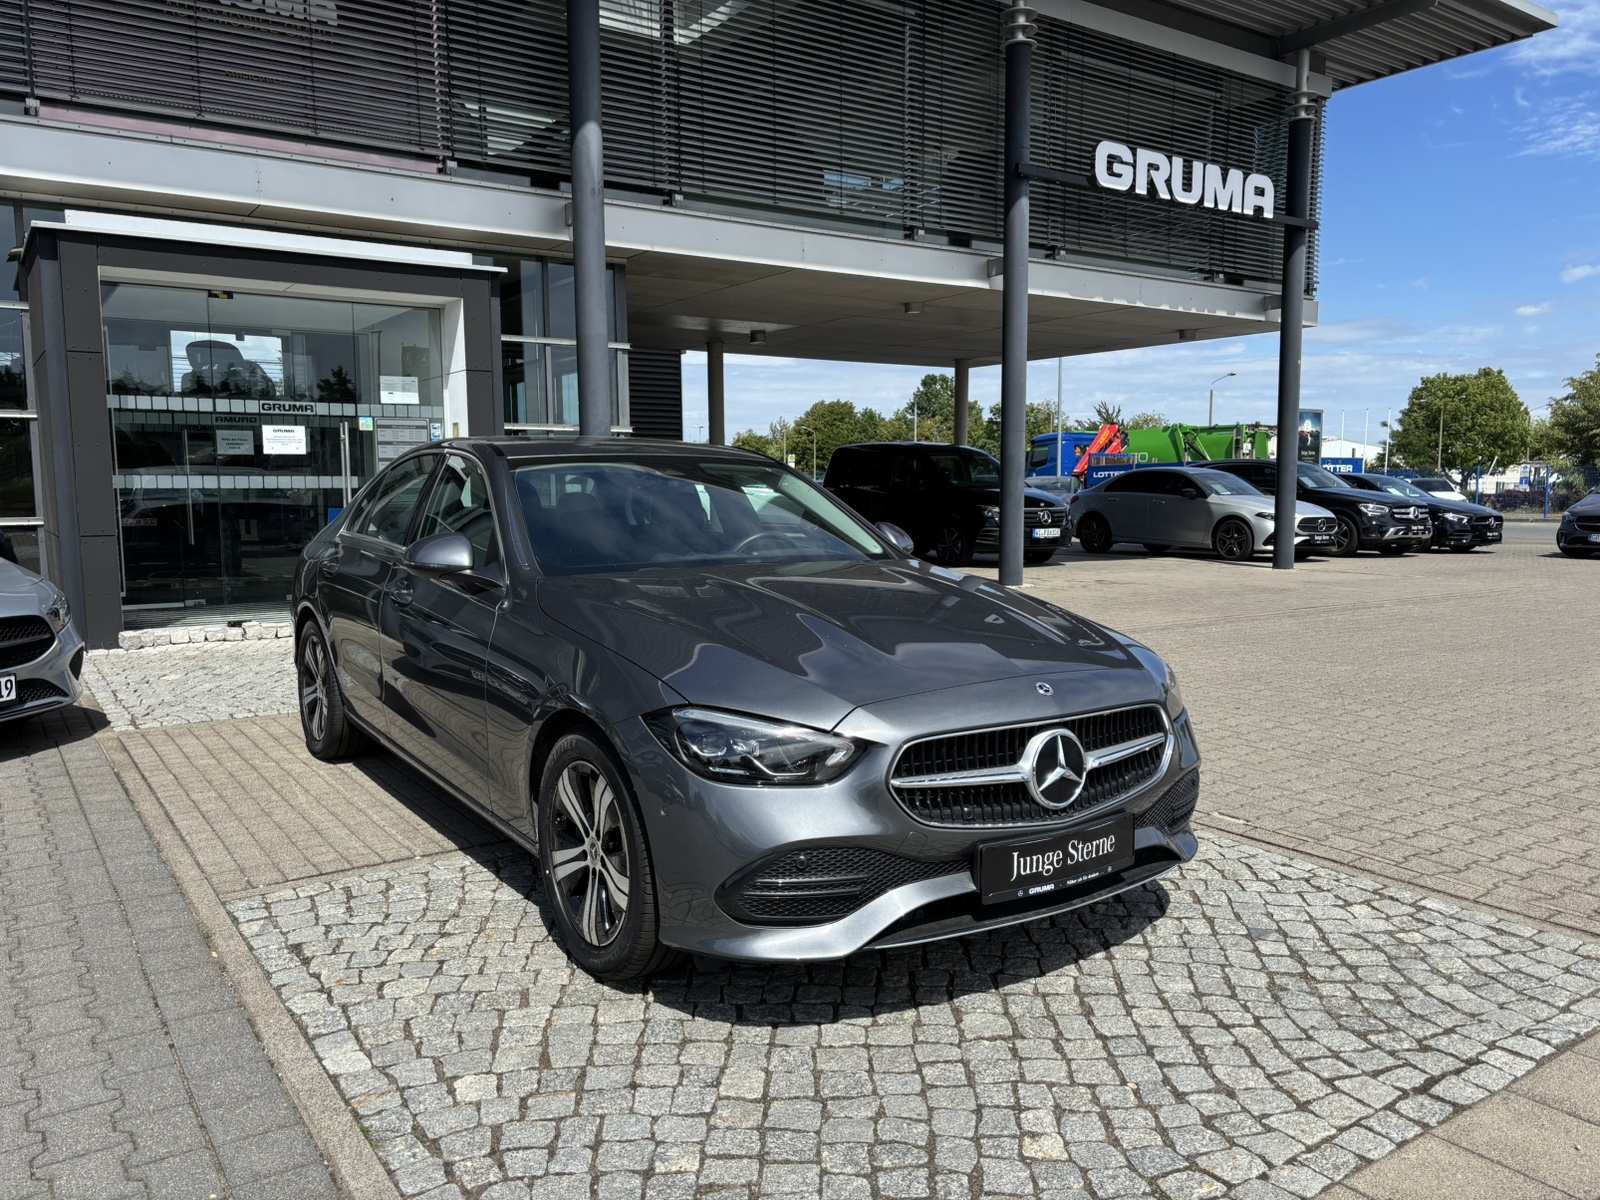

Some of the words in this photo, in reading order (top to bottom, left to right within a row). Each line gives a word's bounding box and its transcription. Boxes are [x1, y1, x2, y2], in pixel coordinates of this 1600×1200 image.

[1095, 140, 1275, 219] GRUMA
[261, 402, 315, 413] GRUMA
[1010, 850, 1063, 882] Junge
[1067, 834, 1115, 865] Sterne
[1028, 883, 1055, 895] GRUMA
